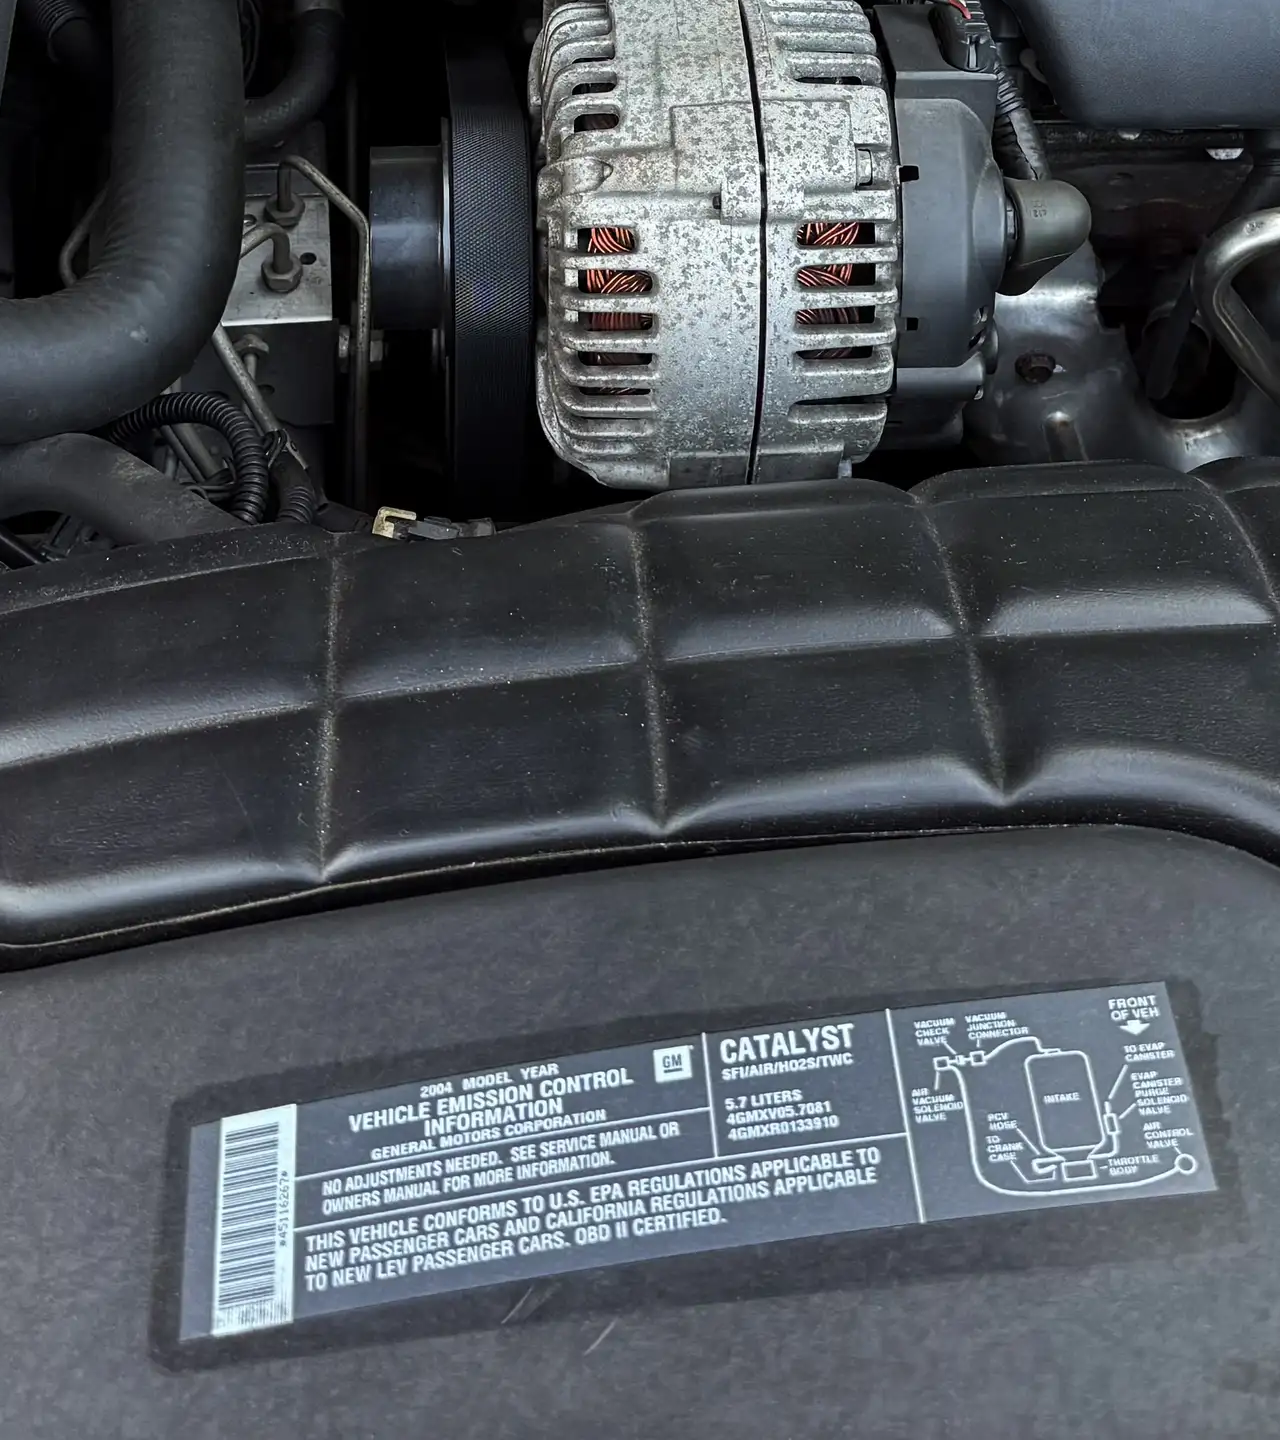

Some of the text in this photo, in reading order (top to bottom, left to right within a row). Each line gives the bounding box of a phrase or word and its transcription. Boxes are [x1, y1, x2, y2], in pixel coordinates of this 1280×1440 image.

[1108, 995, 1157, 1012] FRONT
[1110, 1005, 1161, 1022] OF VEH
[913, 1016, 956, 1030] VACUUM
[964, 1011, 1008, 1024] VACUUM
[914, 1027, 951, 1038] CHECK
[916, 1035, 949, 1047] VALVE
[967, 1026, 1031, 1041] CONNECTOR
[719, 1022, 856, 1065] CATALYST
[1123, 1041, 1166, 1054] TO EVAP
[662, 1053, 683, 1070] GM
[1124, 1049, 1176, 1062] CANISTER
[420, 1063, 560, 1099] 2004 MODEL YEAR
[348, 1068, 635, 1133] VEHICLE EMISSION CONTROL
[724, 1088, 804, 1112] 5.7 LITERS
[1043, 1090, 1082, 1103] INTAKE
[424, 1097, 564, 1138] INFORMATION
[370, 1109, 608, 1161] GENERAL MOTORS CORPORATION
[322, 1121, 682, 1197] NO ADJUSTMENTS NEEDED. SEE SERVICE MANUAL OR
[322, 1150, 617, 1216] OWNERS MANUAL FOR MORE INFORMATION.
[305, 1145, 882, 1254] THIS VEHICLE CONFORMS TO U.S. EPA REGULATIONS APPLICABLE TO
[304, 1166, 879, 1273] NEW PASSENGER CARS AND CALIFORNIA REGULATIONS APPLICABLE
[304, 1207, 729, 1293] TO NEW LEV PASSENGER CARS. OBD II CERTIFIED.
